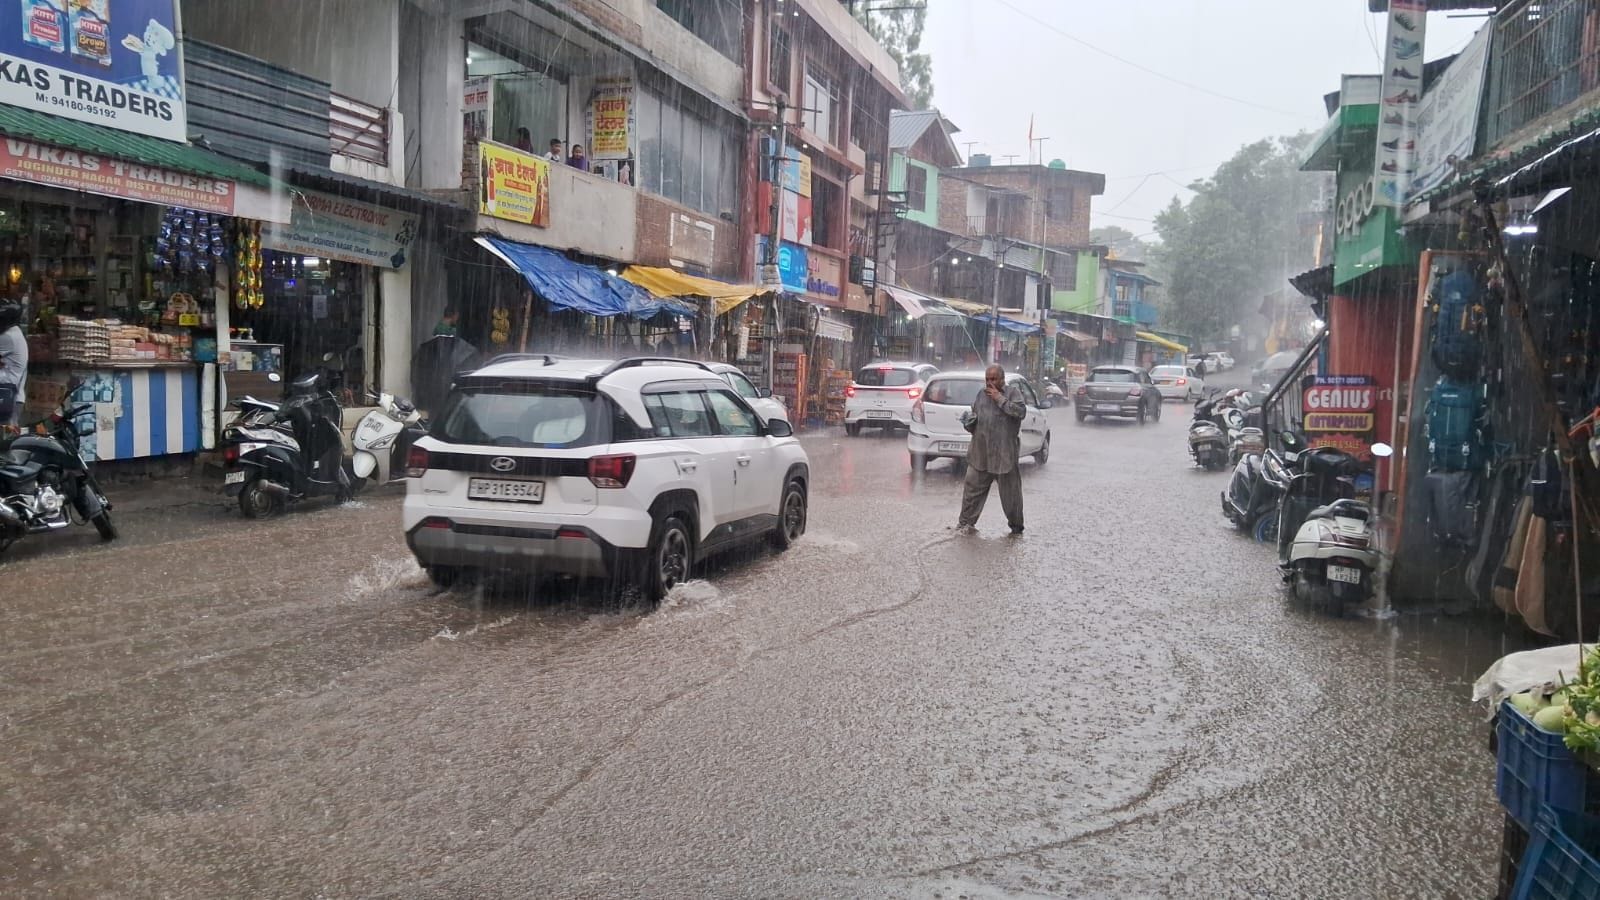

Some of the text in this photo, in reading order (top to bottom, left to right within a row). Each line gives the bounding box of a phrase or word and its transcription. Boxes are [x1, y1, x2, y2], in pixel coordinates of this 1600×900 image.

[34, 8, 55, 21] KITTY
[80, 20, 103, 33] KITTY
[79, 34, 106, 49] Brown
[51, 96, 117, 119] 94180-95192
[59, 74, 173, 121] TRADERS
[6, 139, 230, 196] VIKAS TRADERS
[17, 159, 79, 178] JOGINDER
[160, 186, 194, 199] MANDI
[333, 203, 390, 226] ELECTRONIC
[1308, 389, 1370, 408] GENIUS
